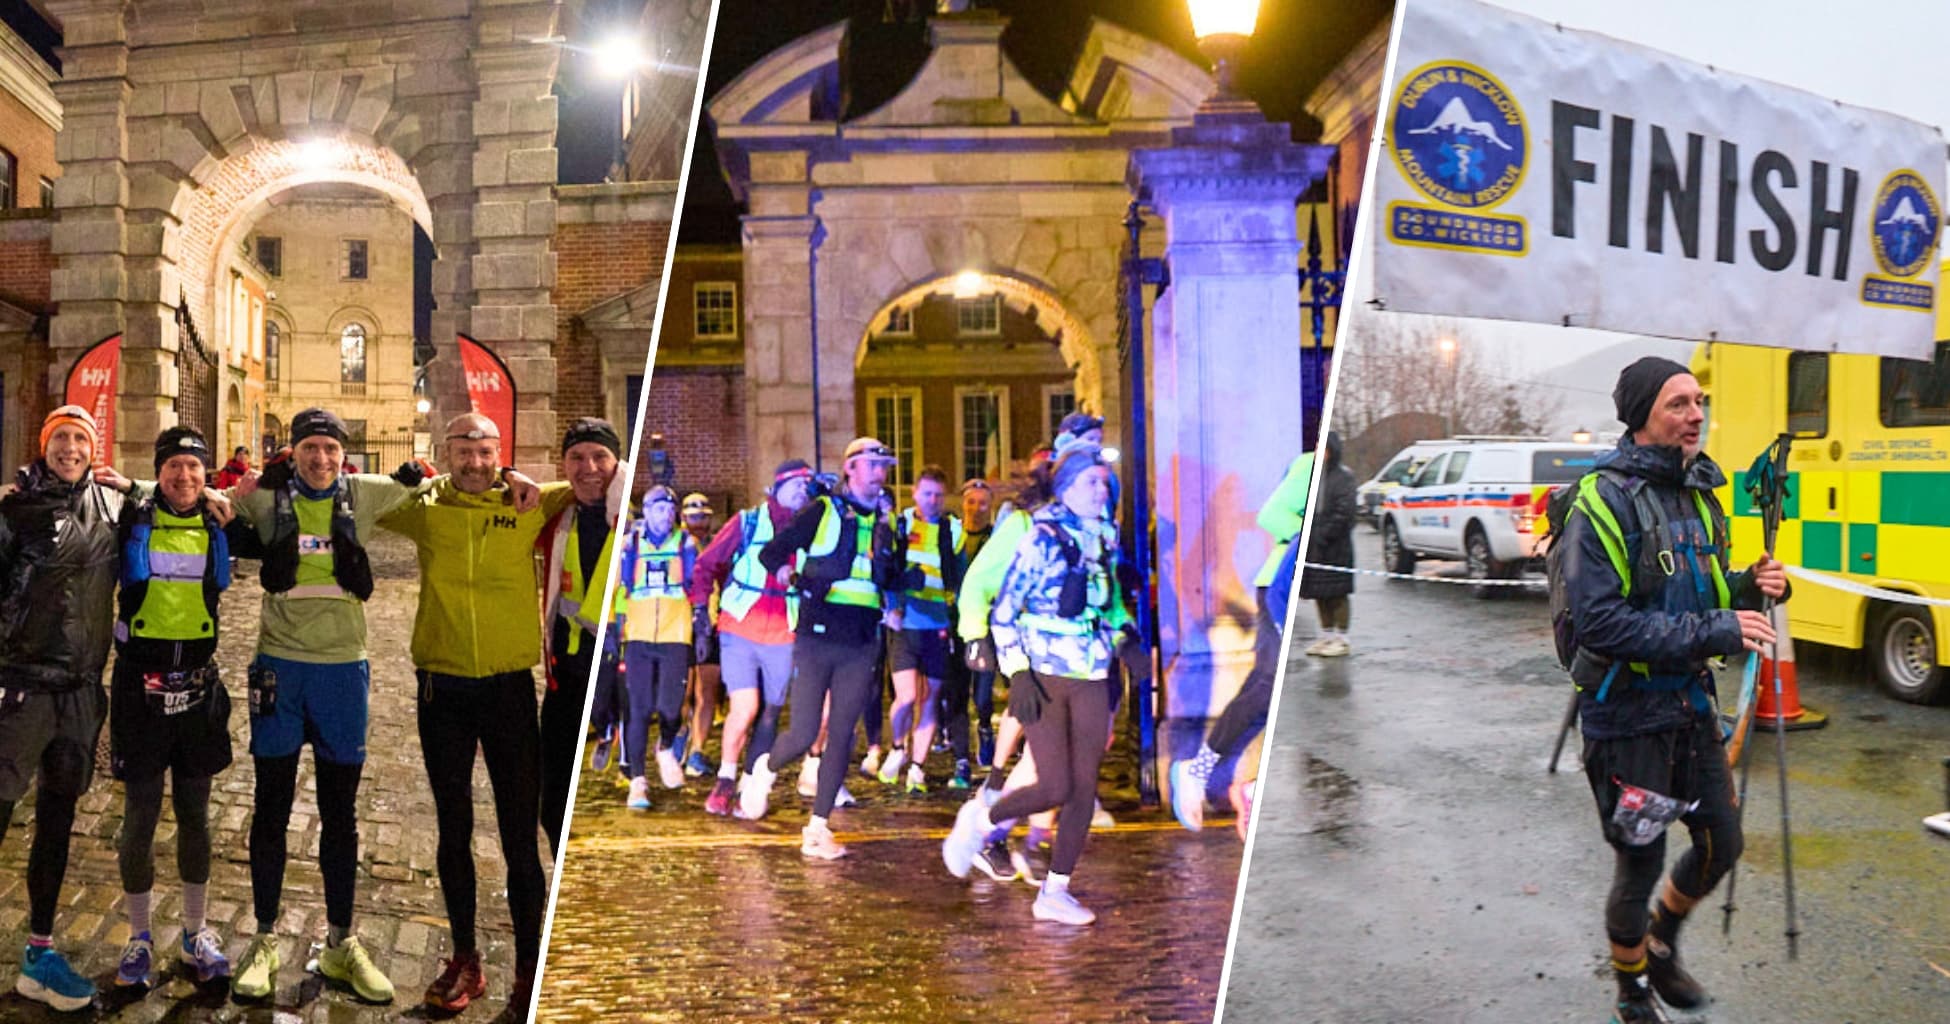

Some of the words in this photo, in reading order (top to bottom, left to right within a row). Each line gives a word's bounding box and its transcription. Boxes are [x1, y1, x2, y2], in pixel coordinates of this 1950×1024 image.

[1401, 71, 1445, 109] DUBLIN
[1461, 72, 1522, 126] WICKLOW
[1399, 148, 1473, 205] MOUNTAIN
[1475, 164, 1522, 203] RESCUE
[1551, 100, 1859, 281] FINISH
[1399, 211, 1518, 234] ROUNDWOOD
[81, 368, 111, 386] HH
[466, 371, 500, 392] HH
[494, 514, 516, 528] HH
